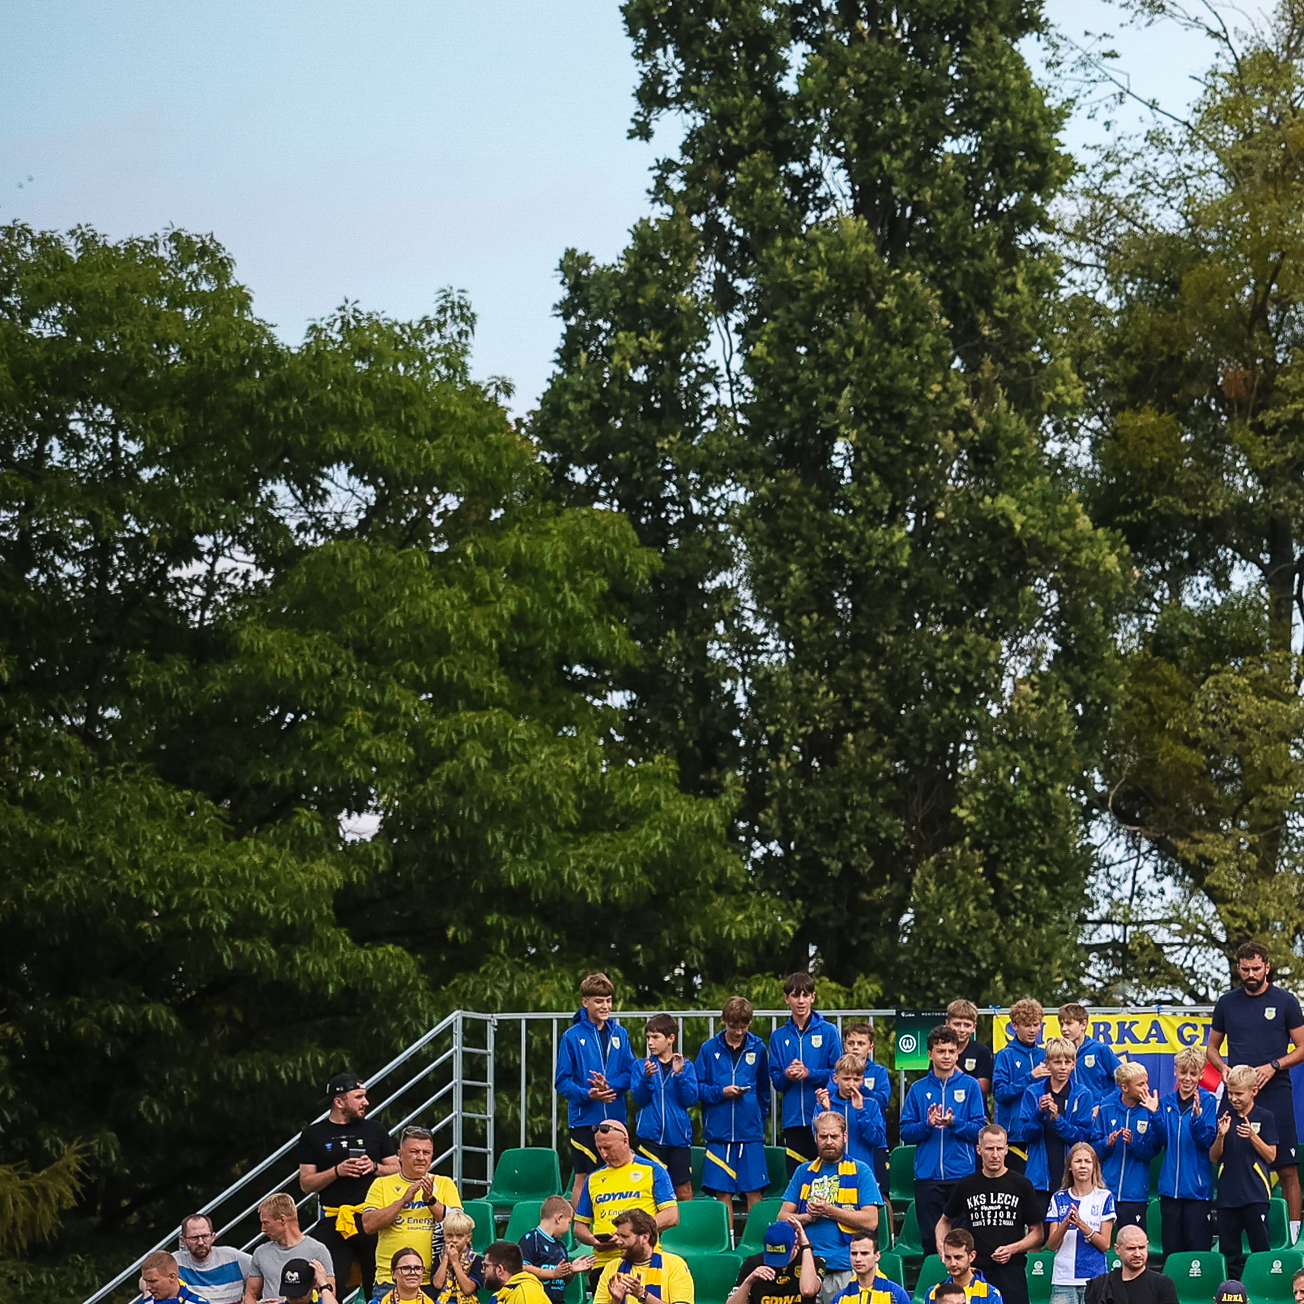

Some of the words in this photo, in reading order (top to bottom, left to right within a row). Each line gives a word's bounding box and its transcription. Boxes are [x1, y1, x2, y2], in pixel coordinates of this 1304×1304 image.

[596, 1191, 640, 1203] GDYNIA
[967, 1192, 986, 1210] KKS
[990, 1192, 1019, 1207] LECH
[1221, 1293, 1243, 1303] ARKA
